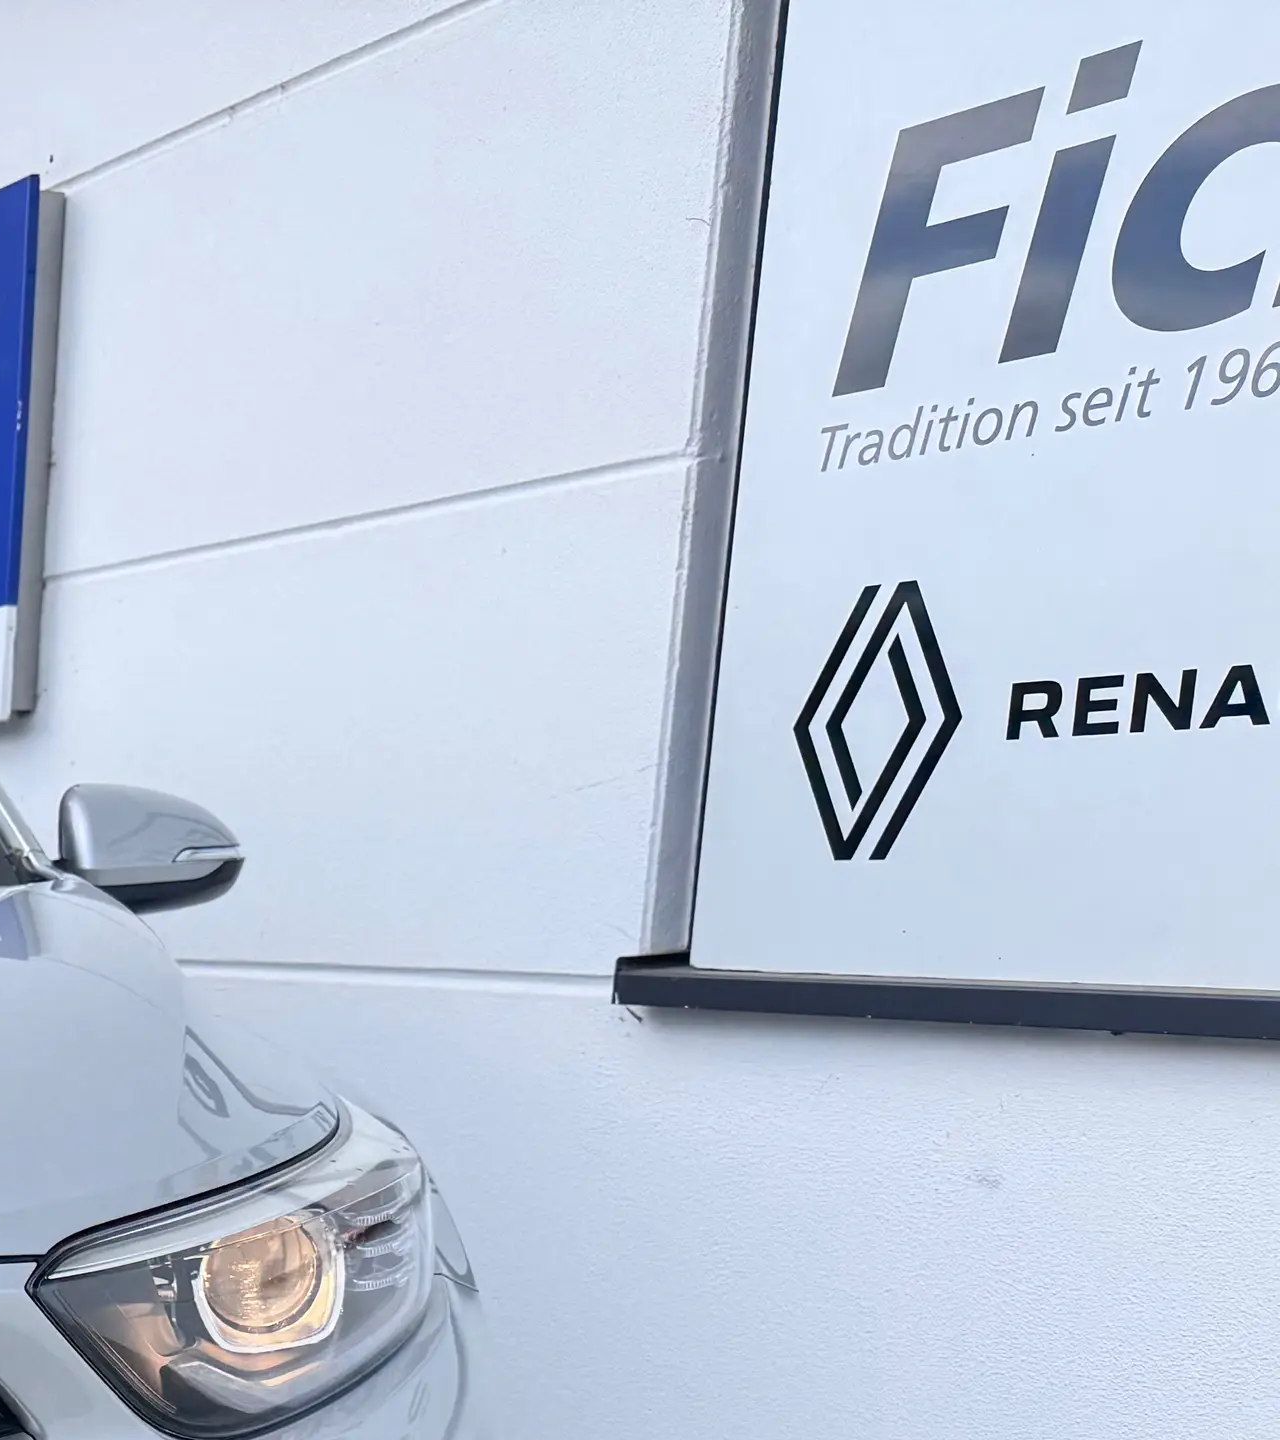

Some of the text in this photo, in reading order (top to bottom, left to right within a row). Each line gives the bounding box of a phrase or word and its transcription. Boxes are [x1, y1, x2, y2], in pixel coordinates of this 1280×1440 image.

[832, 40, 1280, 397] Fic
[820, 397, 1039, 472] Tradition
[1055, 366, 1160, 432] seit
